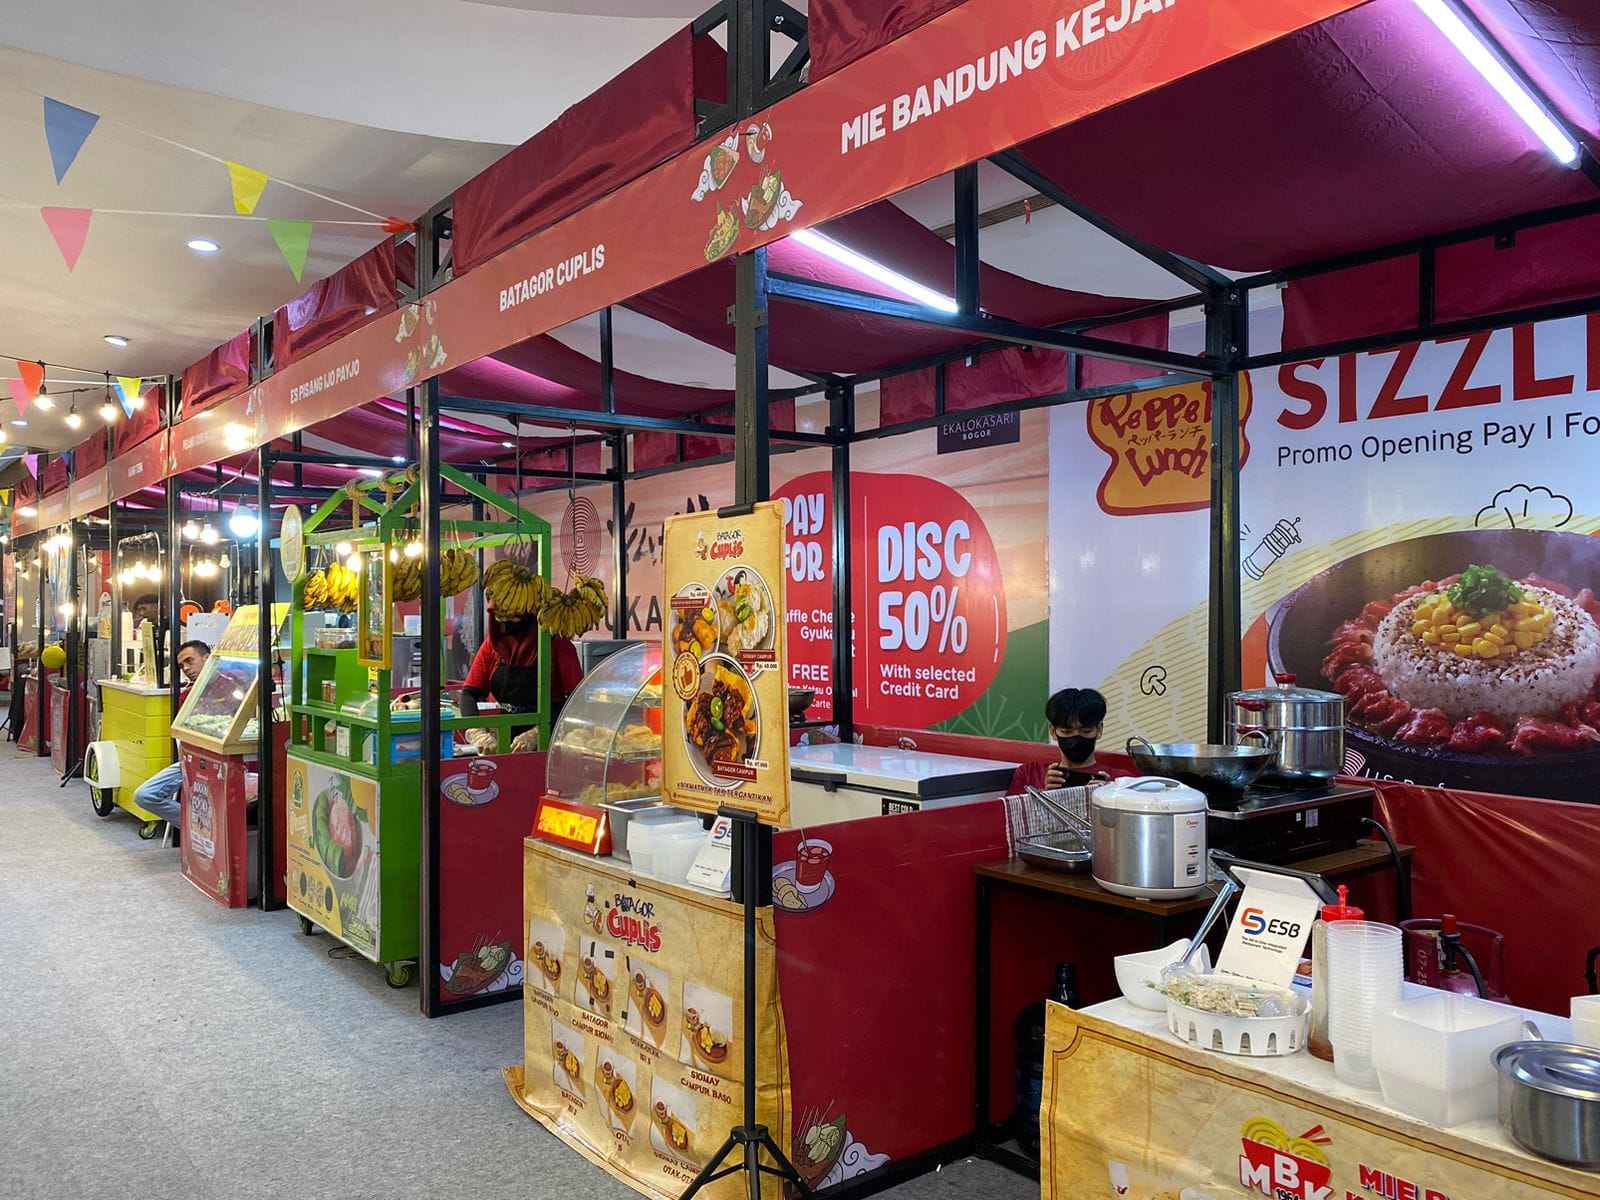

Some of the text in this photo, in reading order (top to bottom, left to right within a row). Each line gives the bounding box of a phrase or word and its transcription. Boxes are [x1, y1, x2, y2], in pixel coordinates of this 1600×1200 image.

[841, 0, 1178, 154] MIE BANDUNG KEJA
[500, 243, 605, 312] BATAGOR CUPLIS
[290, 387, 299, 405] ES
[299, 375, 322, 400] PISANG
[336, 357, 360, 384] PAYJO
[1276, 320, 1600, 430] SIZZL
[943, 410, 1014, 436] EKALOKASARI
[962, 429, 991, 440] BOGOR
[1277, 444, 1352, 467] Promo
[1361, 430, 1473, 462] Opening
[1483, 421, 1535, 449] Pay
[1125, 435, 1208, 487] Lunch
[878, 519, 971, 583] DISC
[878, 584, 968, 654] 50%
[792, 663, 829, 681] FREE
[880, 663, 976, 682] With selected
[880, 681, 959, 700] Credit Card
[615, 893, 654, 918] BATAGOR
[1268, 918, 1301, 938] ESB
[680, 1077, 732, 1104] CAMPUR BASO
[690, 1070, 720, 1086] SIOMAY
[1359, 1163, 1418, 1200] MIE
